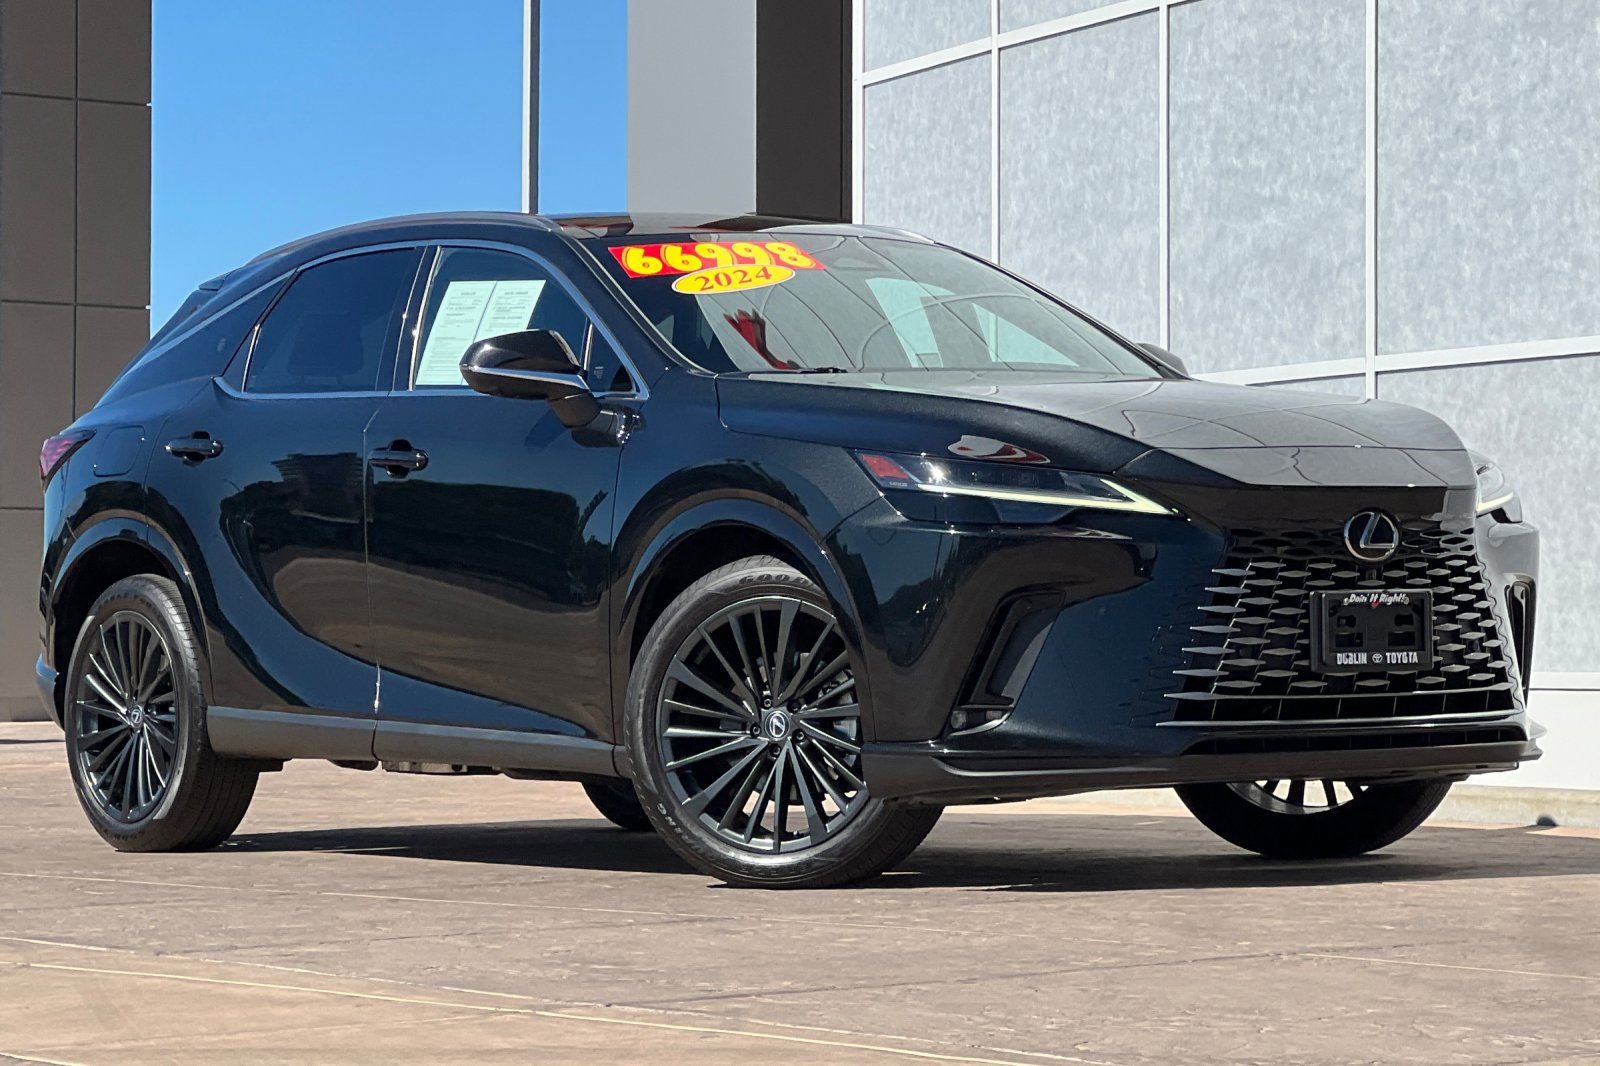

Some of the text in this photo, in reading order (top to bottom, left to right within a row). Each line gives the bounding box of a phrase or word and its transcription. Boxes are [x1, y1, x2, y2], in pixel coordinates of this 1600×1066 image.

[621, 242, 815, 275] 66998
[693, 266, 773, 292] 2024
[1336, 651, 1419, 665] DUBLIN TOYOTA
